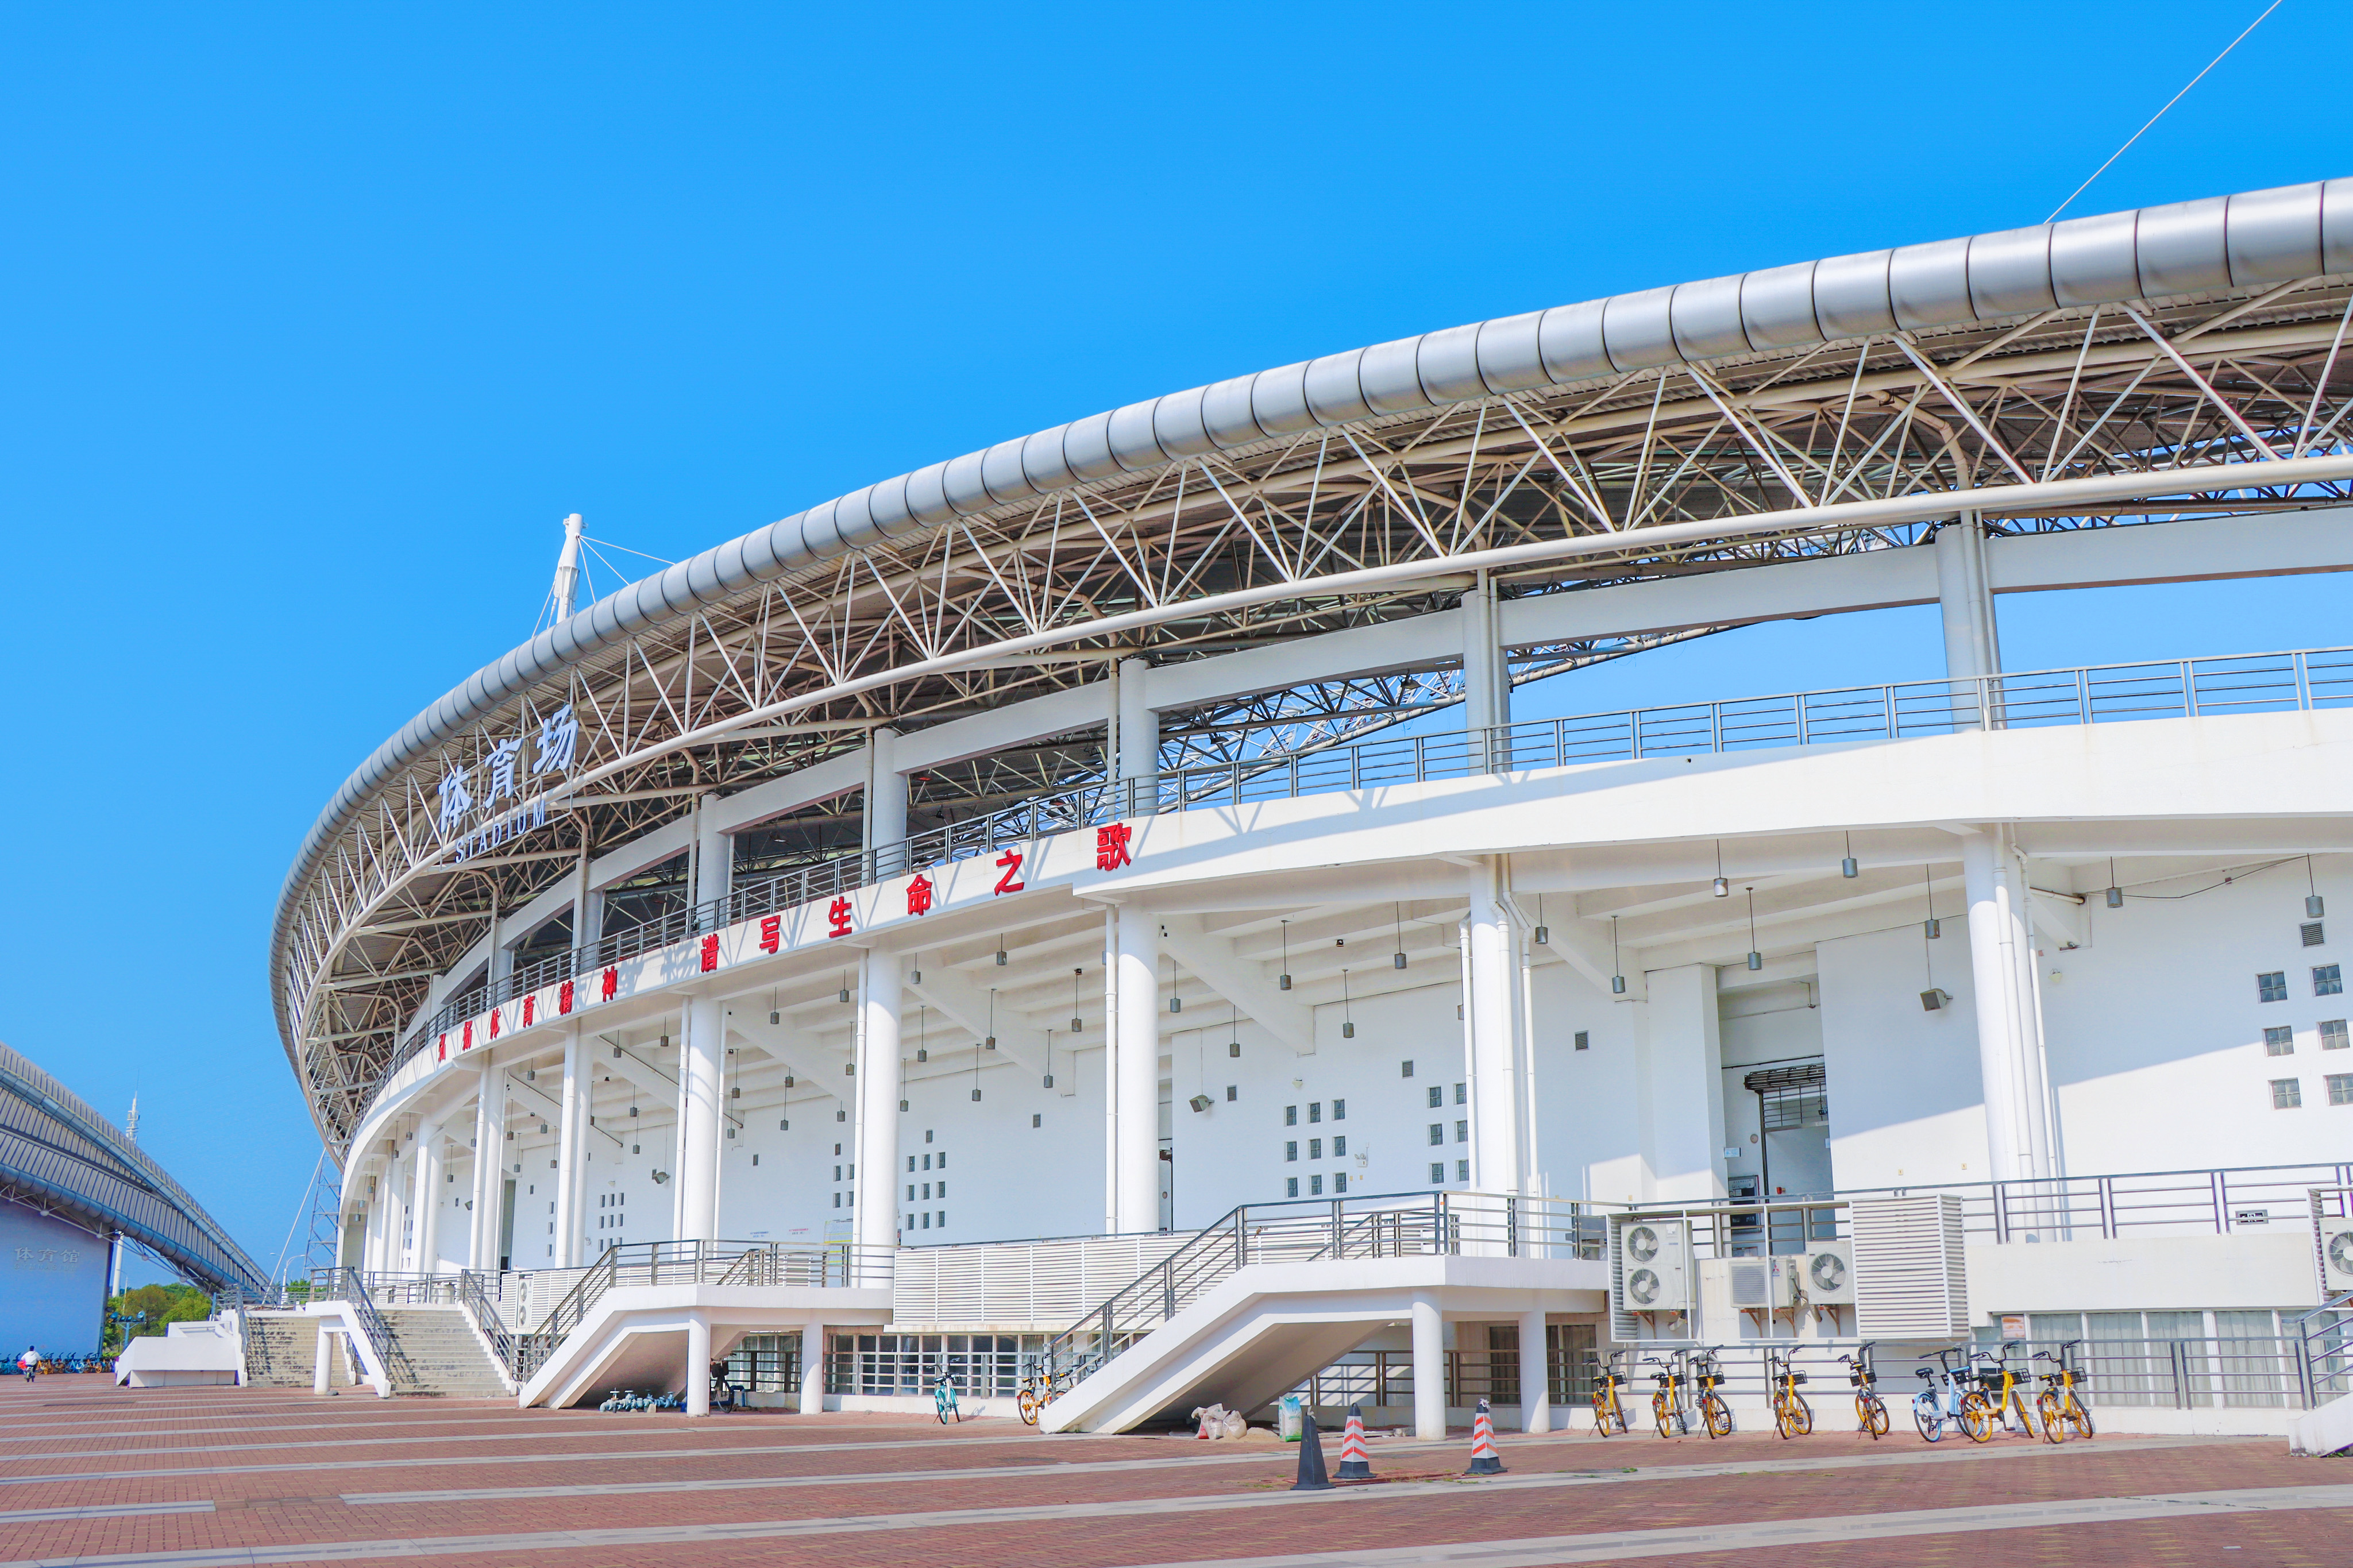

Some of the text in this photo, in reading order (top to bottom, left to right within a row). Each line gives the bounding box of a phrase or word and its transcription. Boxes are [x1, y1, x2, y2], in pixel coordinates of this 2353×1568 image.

[438, 704, 578, 833] 体育场
[456, 800, 545, 863] STADIUM
[700, 822, 1132, 973] 谱写生命之歌
[14, 1247, 80, 1263] 体育馆
